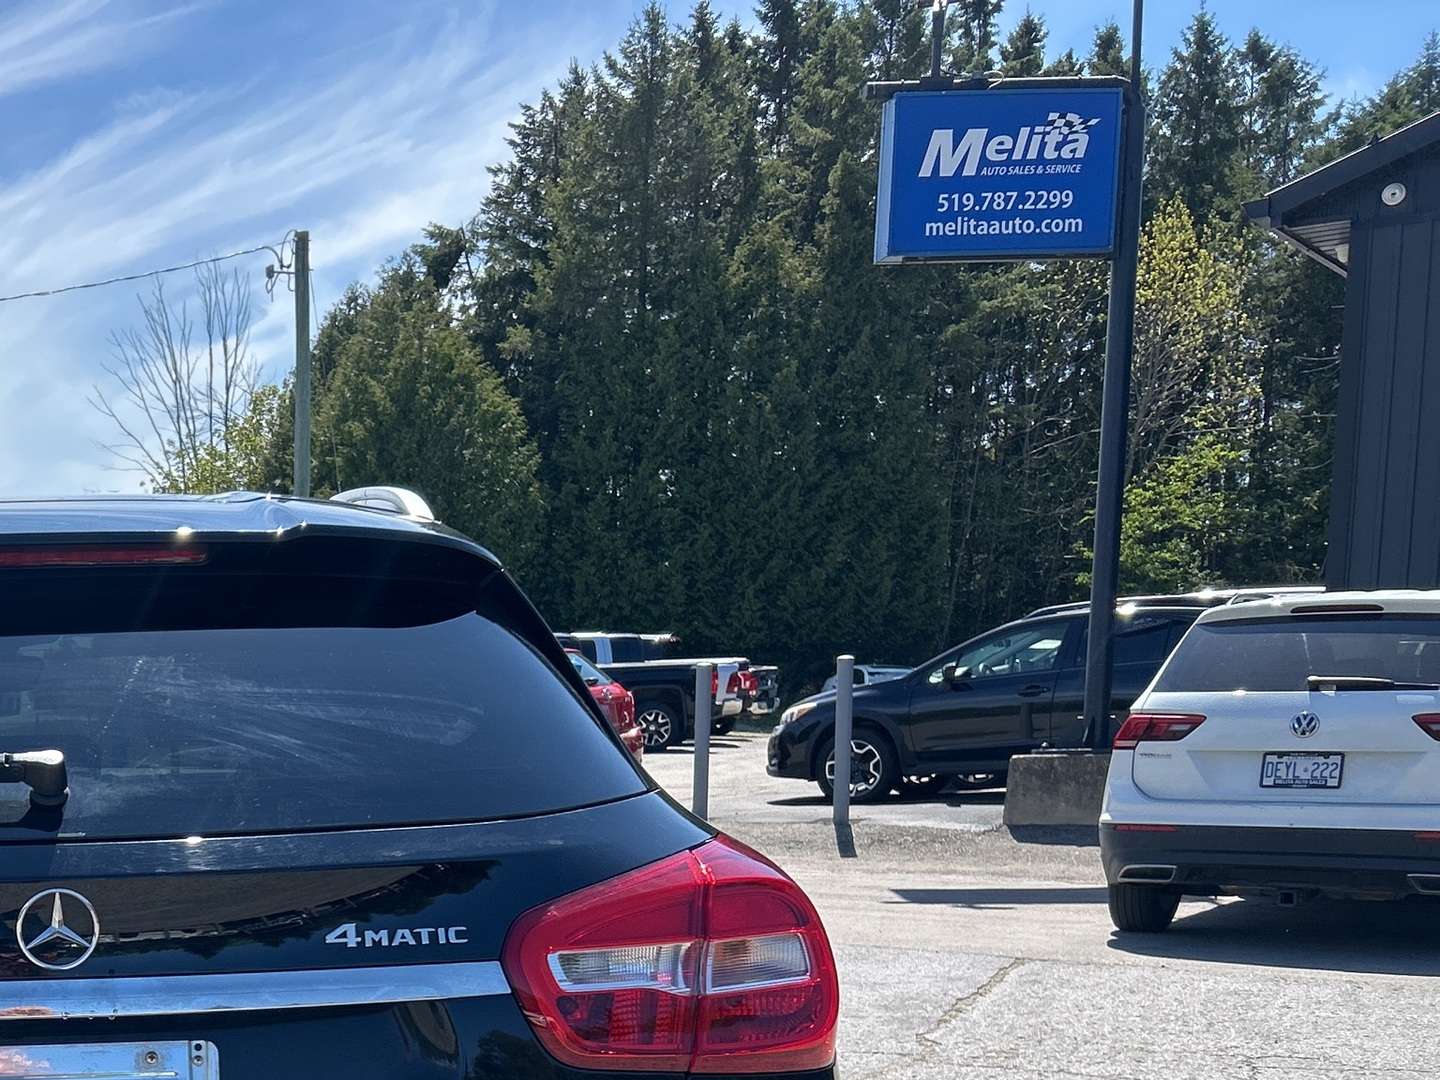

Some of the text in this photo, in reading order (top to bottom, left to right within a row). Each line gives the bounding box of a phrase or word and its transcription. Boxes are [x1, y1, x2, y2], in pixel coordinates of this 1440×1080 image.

[918, 126, 1090, 177] Melita
[980, 164, 1083, 176] AUTO SALES & SERVICE
[937, 190, 1074, 212] 519.787.2299
[925, 216, 1083, 237] melitaauto.com
[1265, 761, 1339, 779] DEYL 222
[325, 922, 469, 947] 4MATIC
